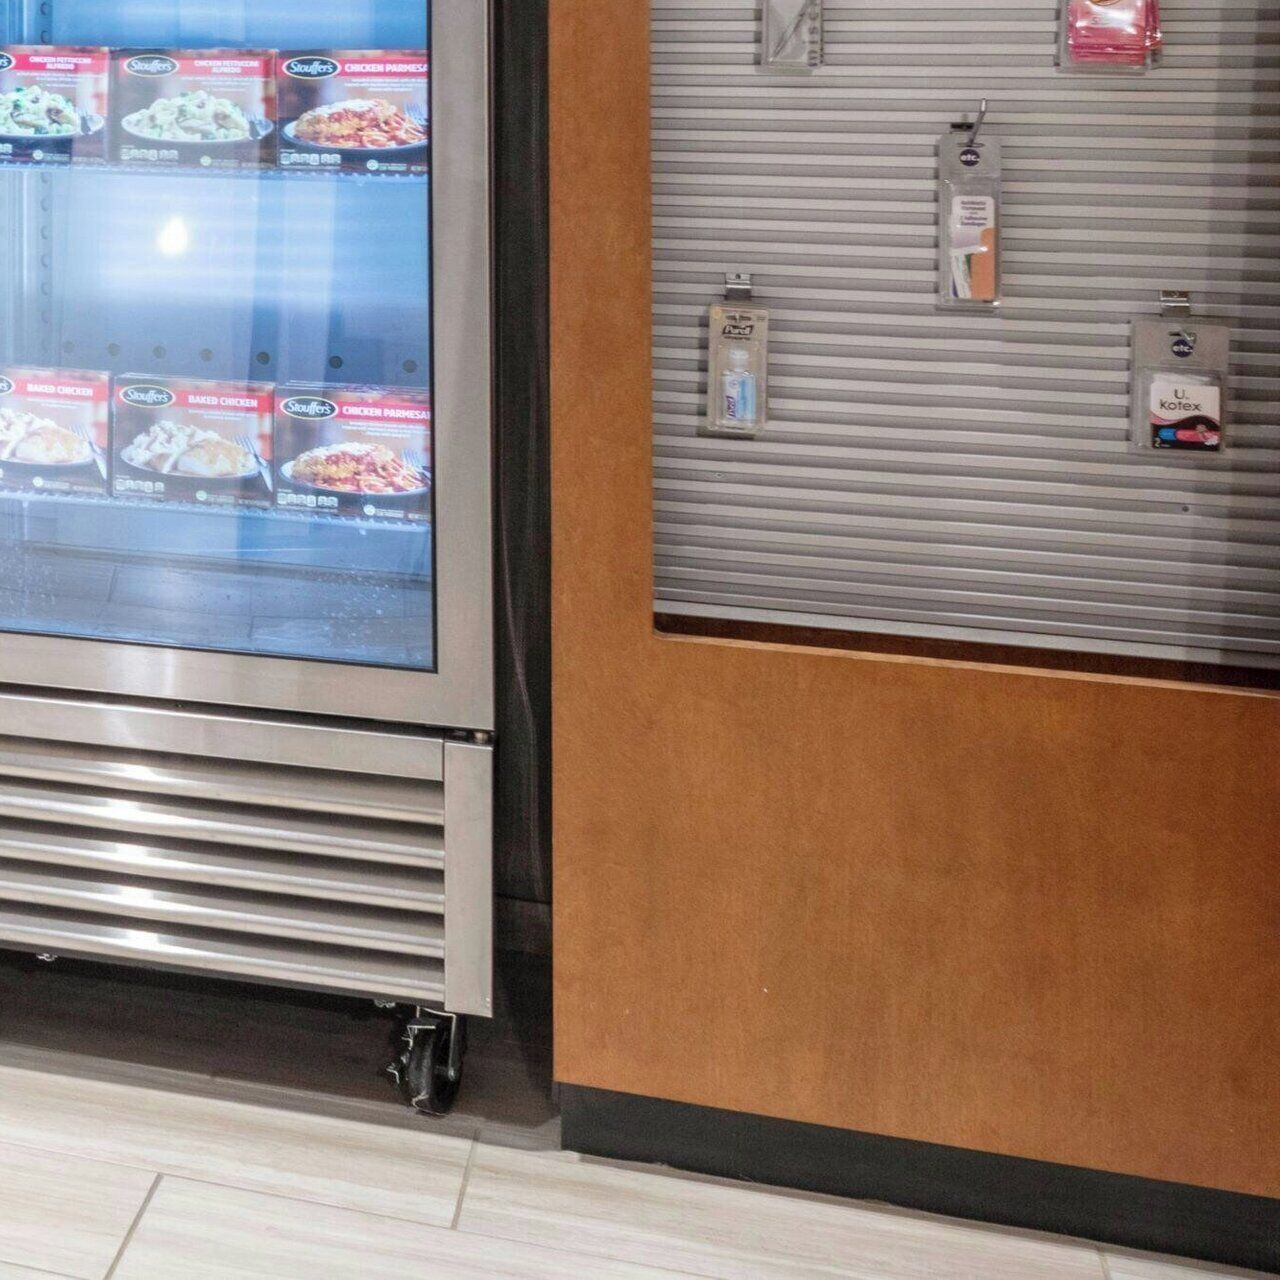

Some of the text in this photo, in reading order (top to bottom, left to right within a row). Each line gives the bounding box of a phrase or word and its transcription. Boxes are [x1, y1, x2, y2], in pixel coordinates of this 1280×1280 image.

[289, 59, 335, 76] Stouffer's
[344, 63, 385, 73] CHICKEN
[27, 383, 93, 396] BAKED CHICKEN
[125, 389, 170, 405] Stouffer's
[188, 395, 259, 407] BAKED CHICKEN
[287, 401, 333, 417] Stouffer's
[342, 405, 383, 418] CHICKEN
[1160, 399, 1202, 412] kotex
